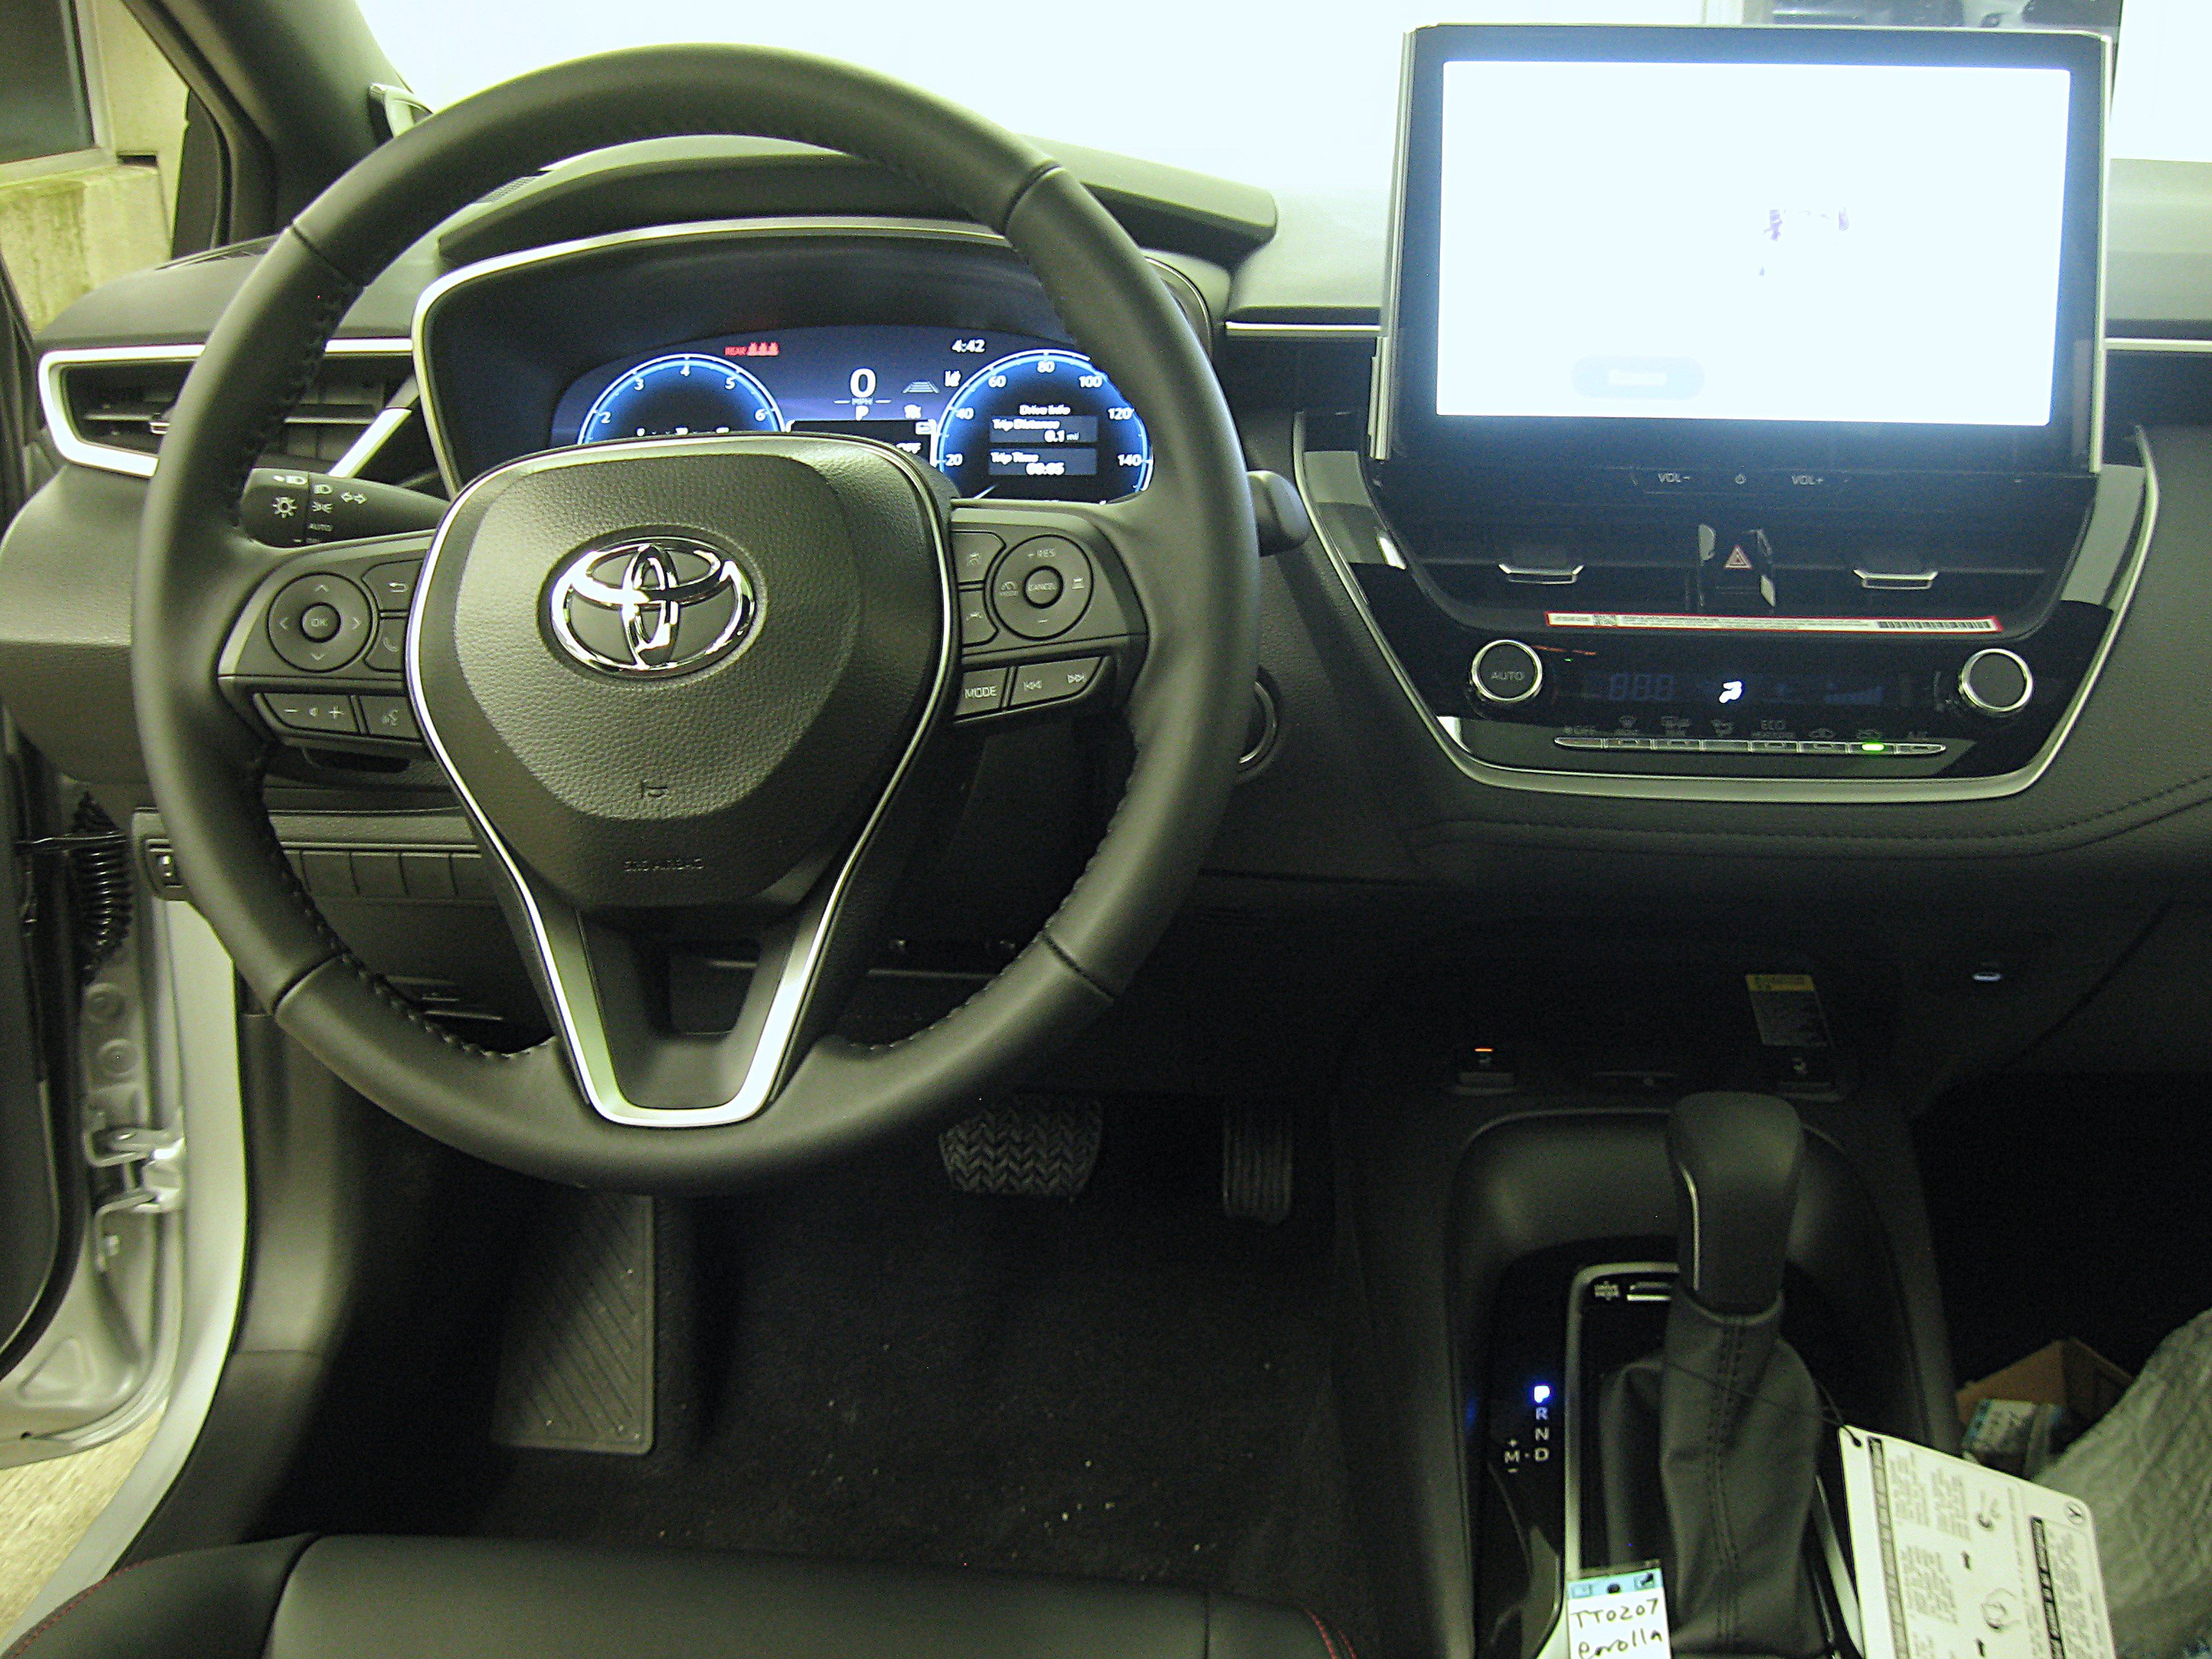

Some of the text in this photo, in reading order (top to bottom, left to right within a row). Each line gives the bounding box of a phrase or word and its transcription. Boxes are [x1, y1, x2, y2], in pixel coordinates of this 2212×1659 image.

[724, 346, 747, 356] REAR
[952, 339, 986, 353] 4:42
[680, 364, 691, 377] 4
[1037, 361, 1055, 374] 80
[634, 378, 645, 391] 3
[725, 377, 736, 390] 5
[850, 368, 876, 397] 0
[988, 375, 1007, 388] 60
[1079, 375, 1103, 388] 100
[755, 409, 766, 421] 6
[956, 407, 974, 420] 40
[1019, 404, 1071, 415] Drive Info
[1108, 408, 1133, 421] 120
[601, 411, 611, 423] 2
[992, 418, 1060, 431] Trip Distance
[946, 454, 963, 467] 20
[990, 451, 1039, 465] Trip Time
[1118, 454, 1142, 467] 140
[310, 619, 328, 627] OK
[1491, 670, 1524, 680] AUTO
[965, 685, 998, 698] MODE
[1534, 1385, 1550, 1403] P
[1535, 1407, 1548, 1420] R
[1534, 1427, 1550, 1441] N
[1504, 1450, 1520, 1463] M
[1534, 1447, 1549, 1462] D
